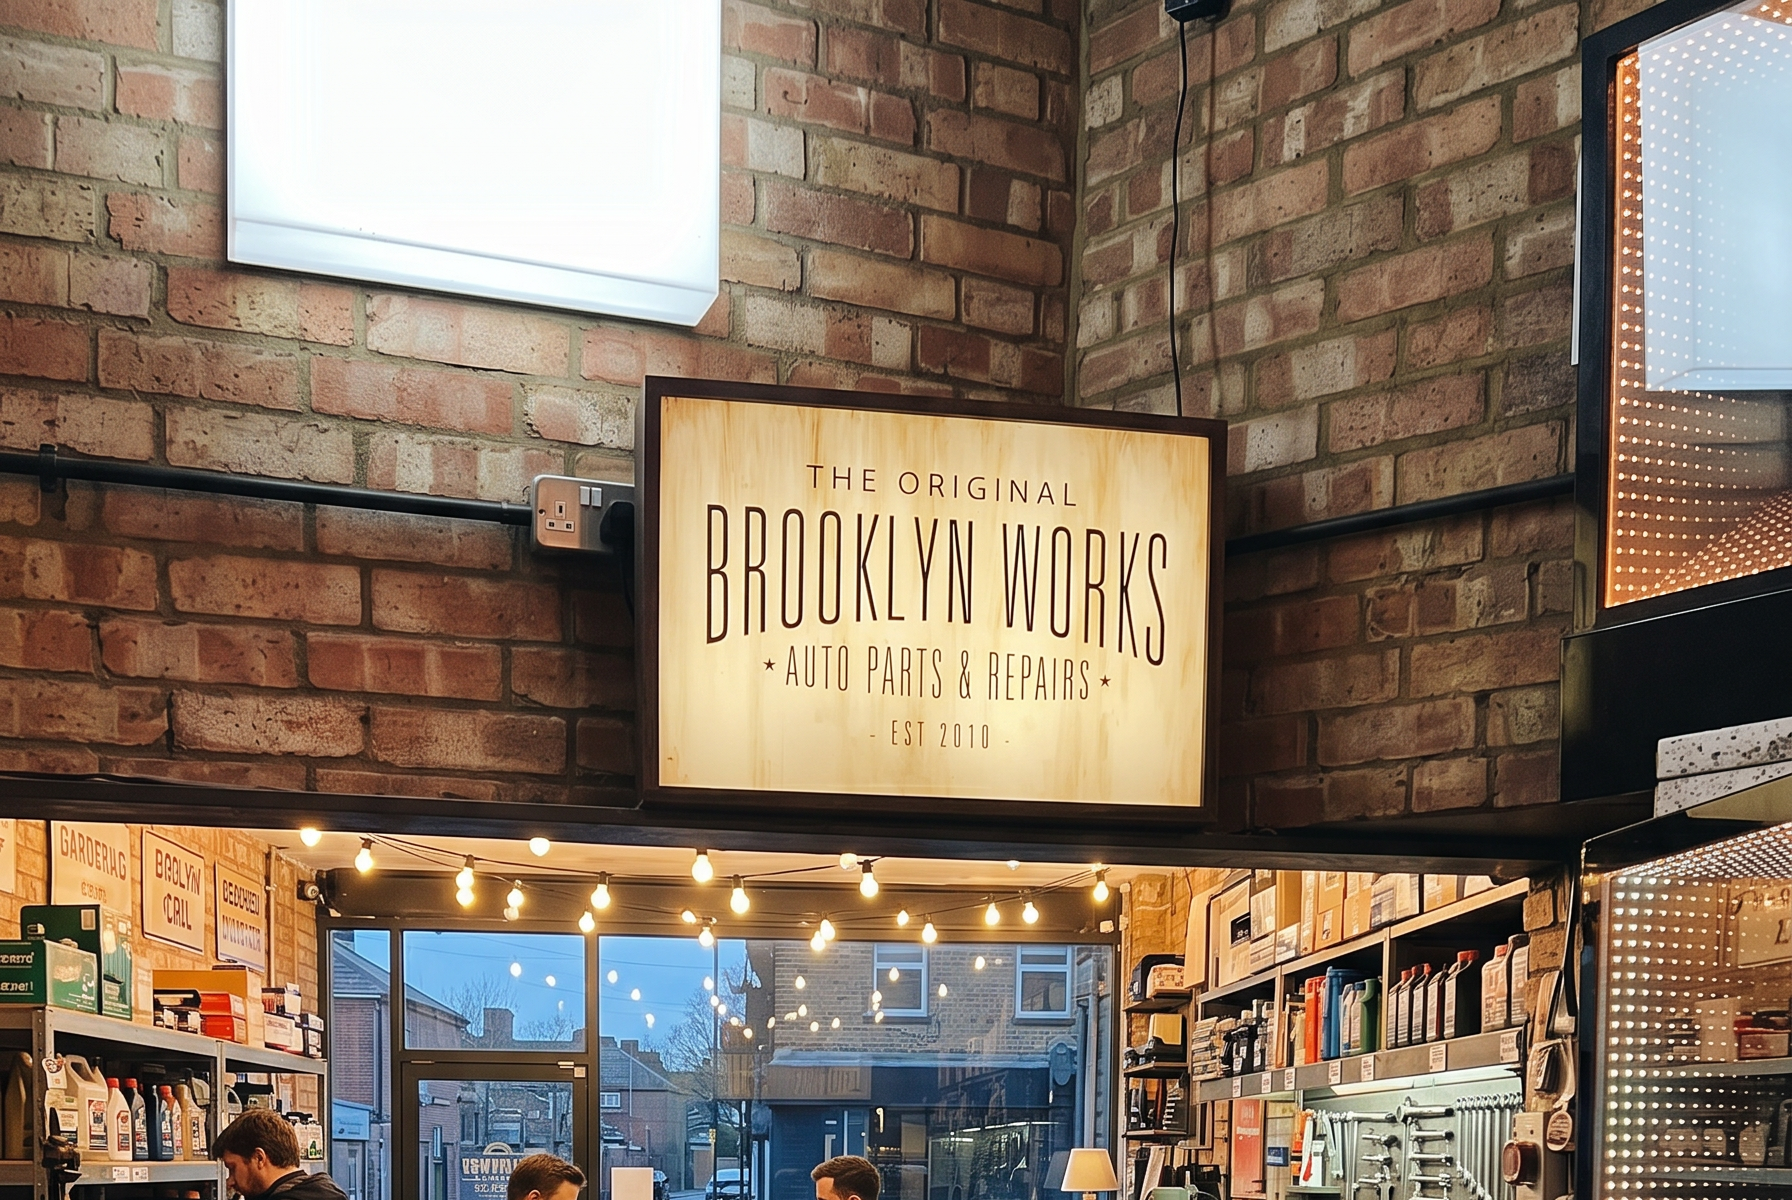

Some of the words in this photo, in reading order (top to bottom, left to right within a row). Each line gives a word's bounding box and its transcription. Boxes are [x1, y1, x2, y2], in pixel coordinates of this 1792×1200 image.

[806, 464, 877, 493] THE
[898, 470, 1077, 507] ORIGINAL
[706, 503, 974, 645] BROOKLYN
[1002, 522, 1168, 667] WORKS
[785, 645, 849, 692] AUTO
[867, 645, 942, 699] PARTS
[959, 650, 971, 699] &
[988, 651, 1090, 701] REPAIRS
[891, 720, 925, 747] EST
[940, 722, 990, 749] 2010
